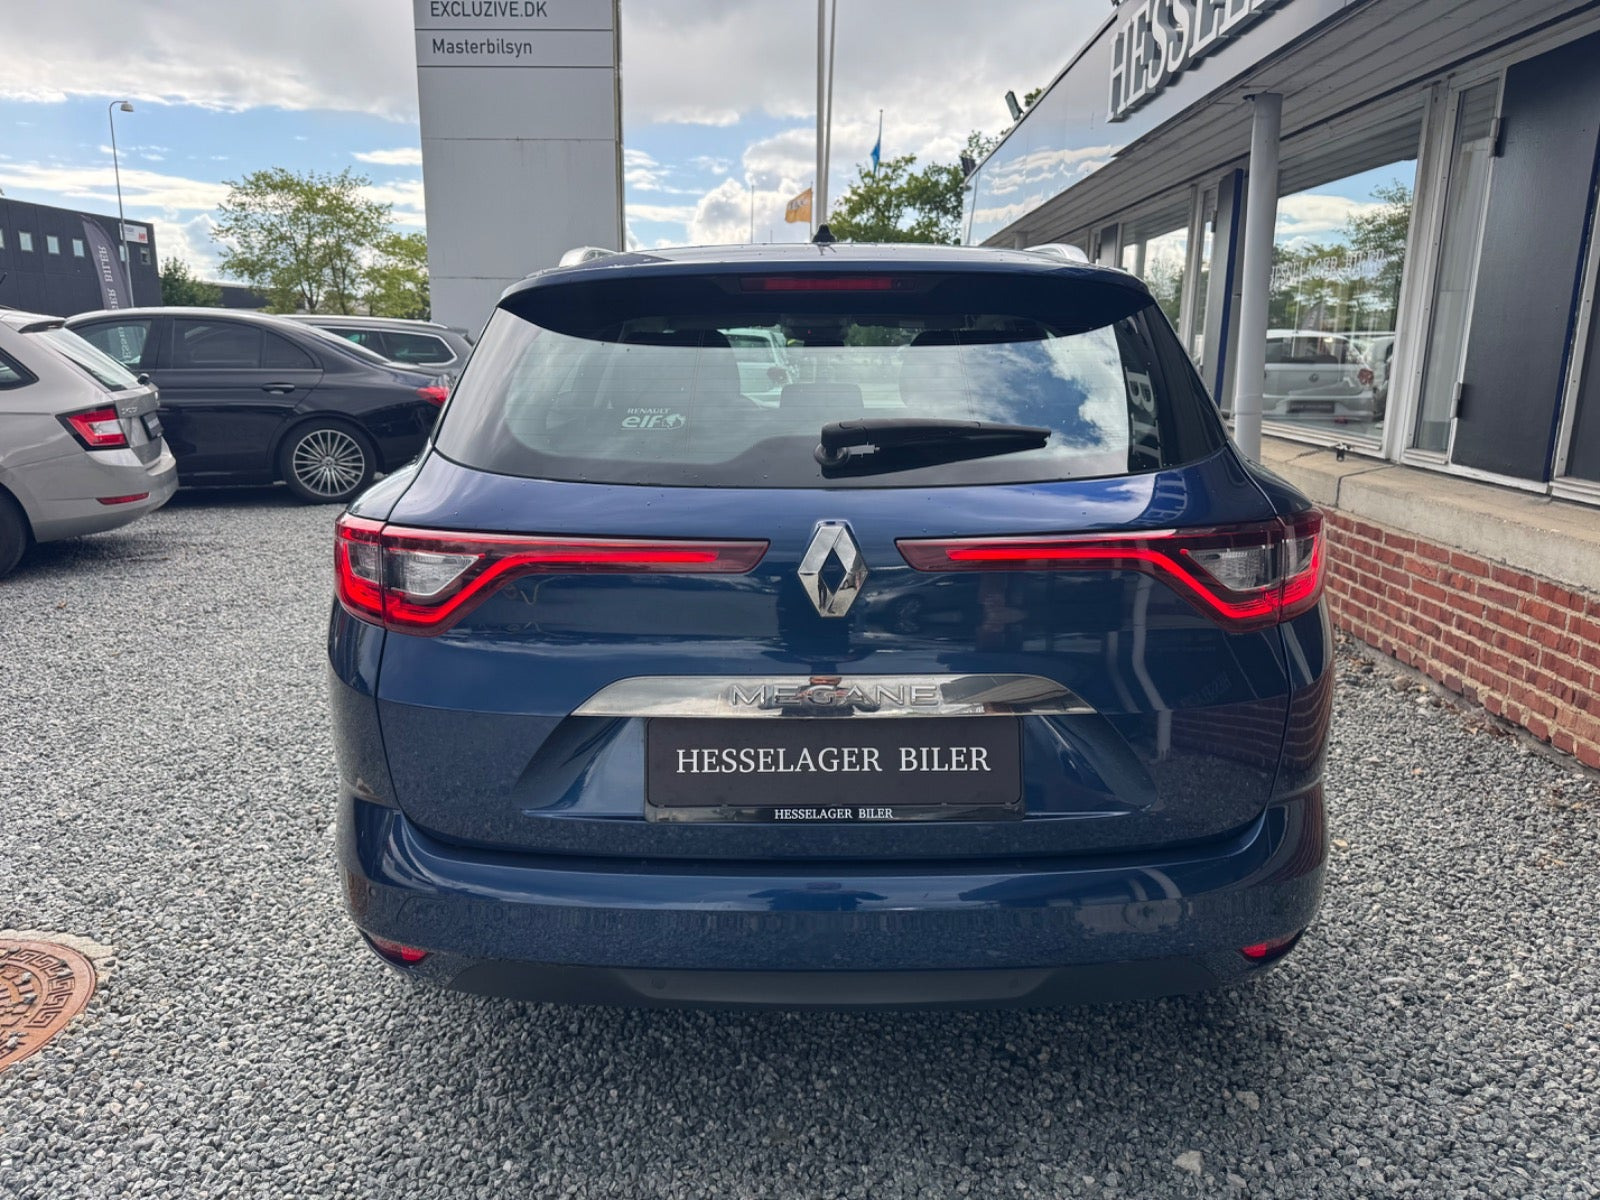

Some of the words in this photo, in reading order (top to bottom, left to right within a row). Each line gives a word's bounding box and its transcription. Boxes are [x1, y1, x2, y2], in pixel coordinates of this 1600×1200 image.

[430, 1, 548, 18] EXCLUZIVE.DK
[432, 38, 533, 58] Masterbilsyn
[627, 407, 671, 415] RENAULT
[731, 684, 939, 707] MEGANE
[676, 747, 883, 773] HESSELAGER
[899, 747, 992, 772] BILER
[774, 808, 853, 820] HESSELAGER
[858, 808, 894, 819] BILER
